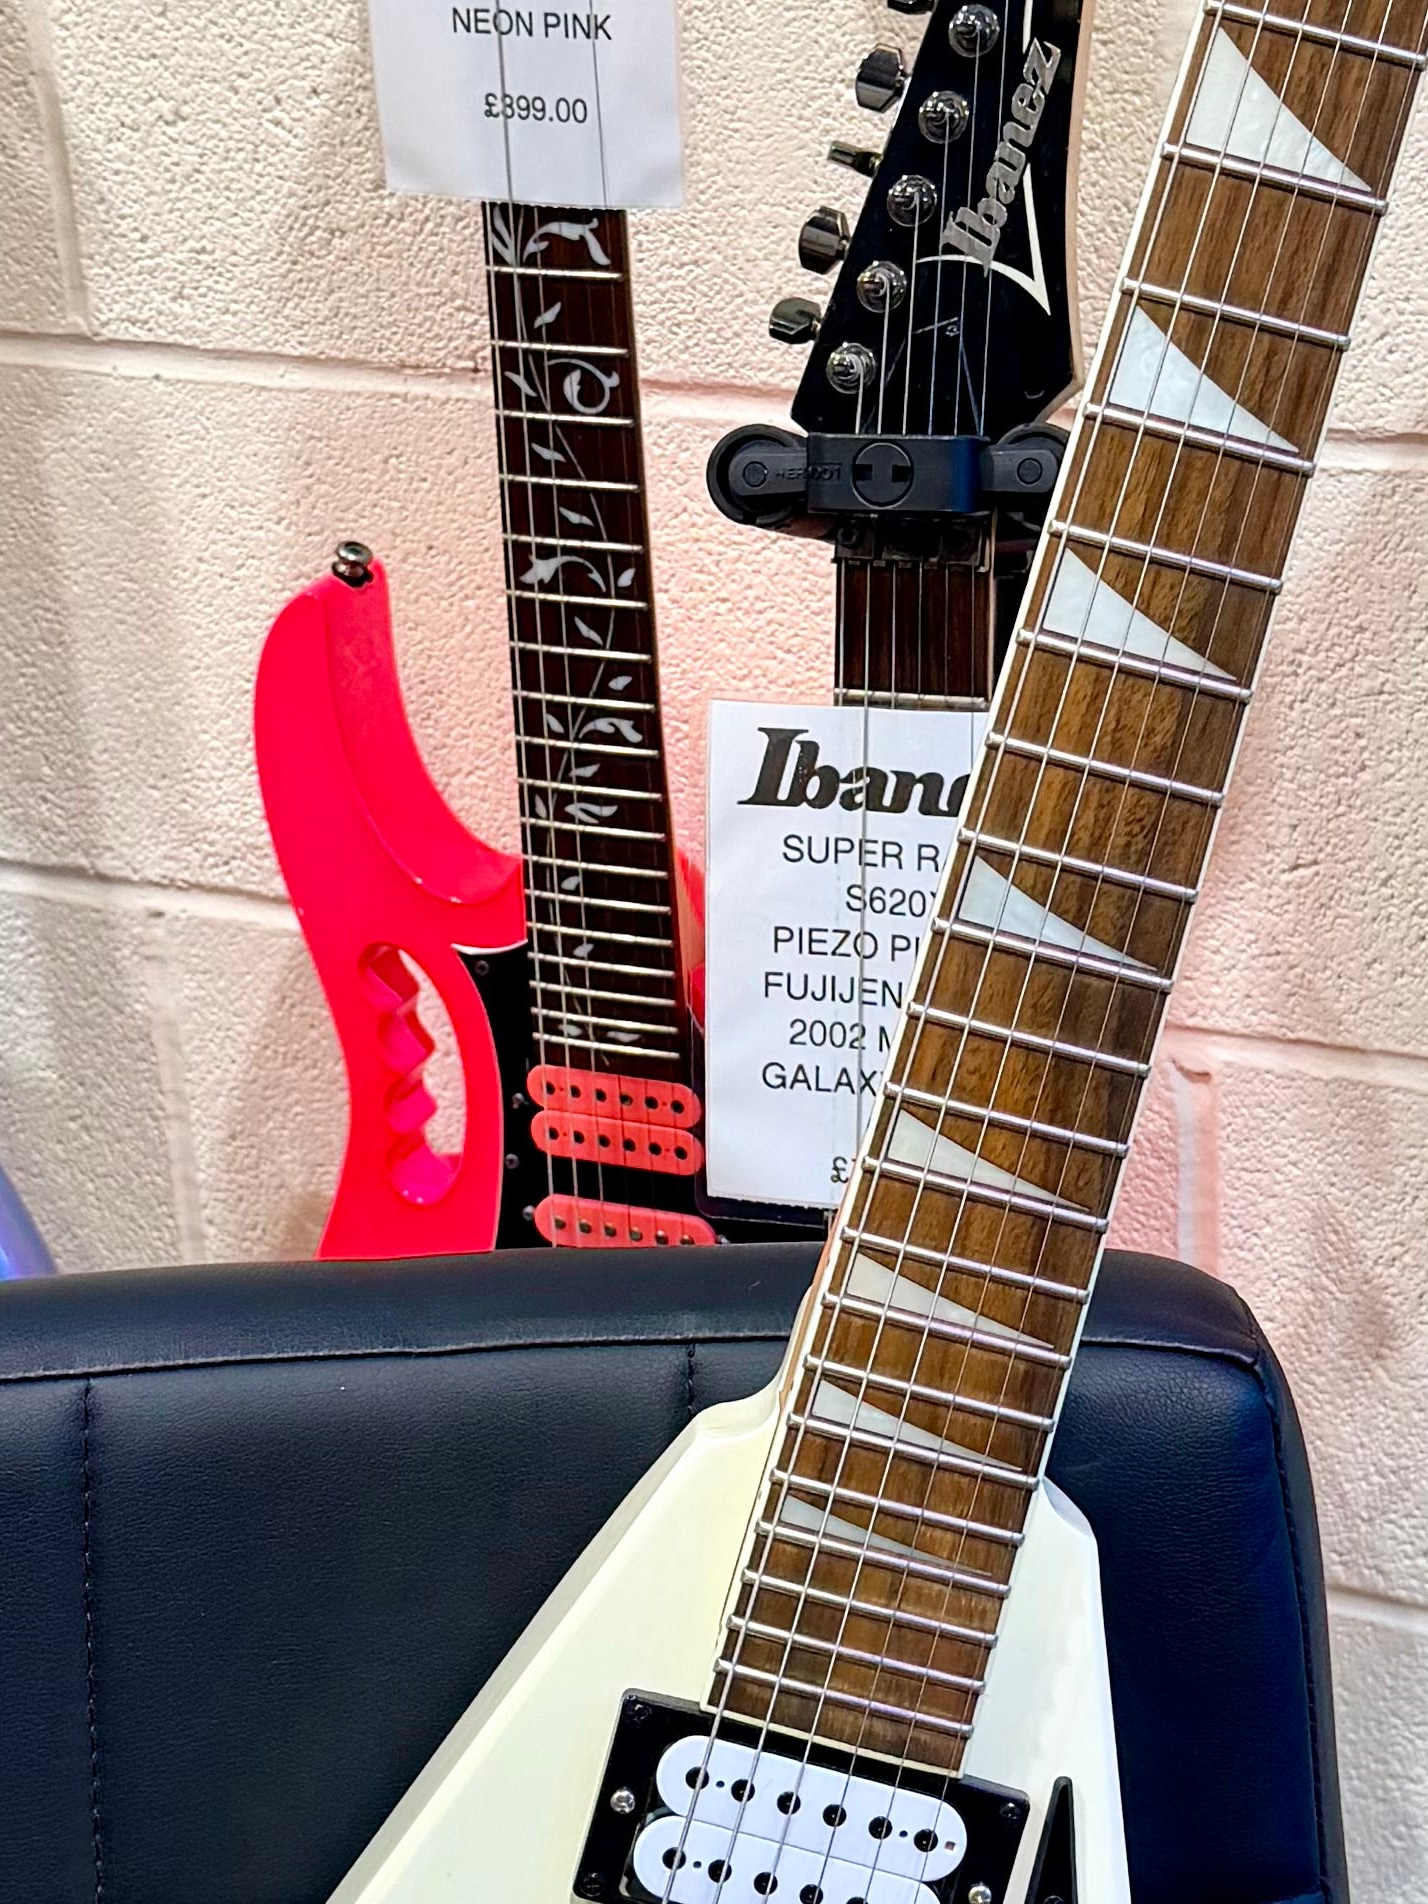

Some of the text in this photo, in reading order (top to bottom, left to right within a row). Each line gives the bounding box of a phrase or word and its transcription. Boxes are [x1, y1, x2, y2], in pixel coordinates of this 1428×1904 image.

[452, 7, 613, 41] NEON PINK
[938, 36, 1063, 279] Ibanez
[781, 833, 945, 874] SUPER R
[845, 883, 936, 918] S620
[773, 925, 879, 960] PIEZO
[764, 971, 903, 1009] FUJIJEN
[788, 1018, 867, 1050] 2002
[761, 1061, 884, 1097] GALAX
